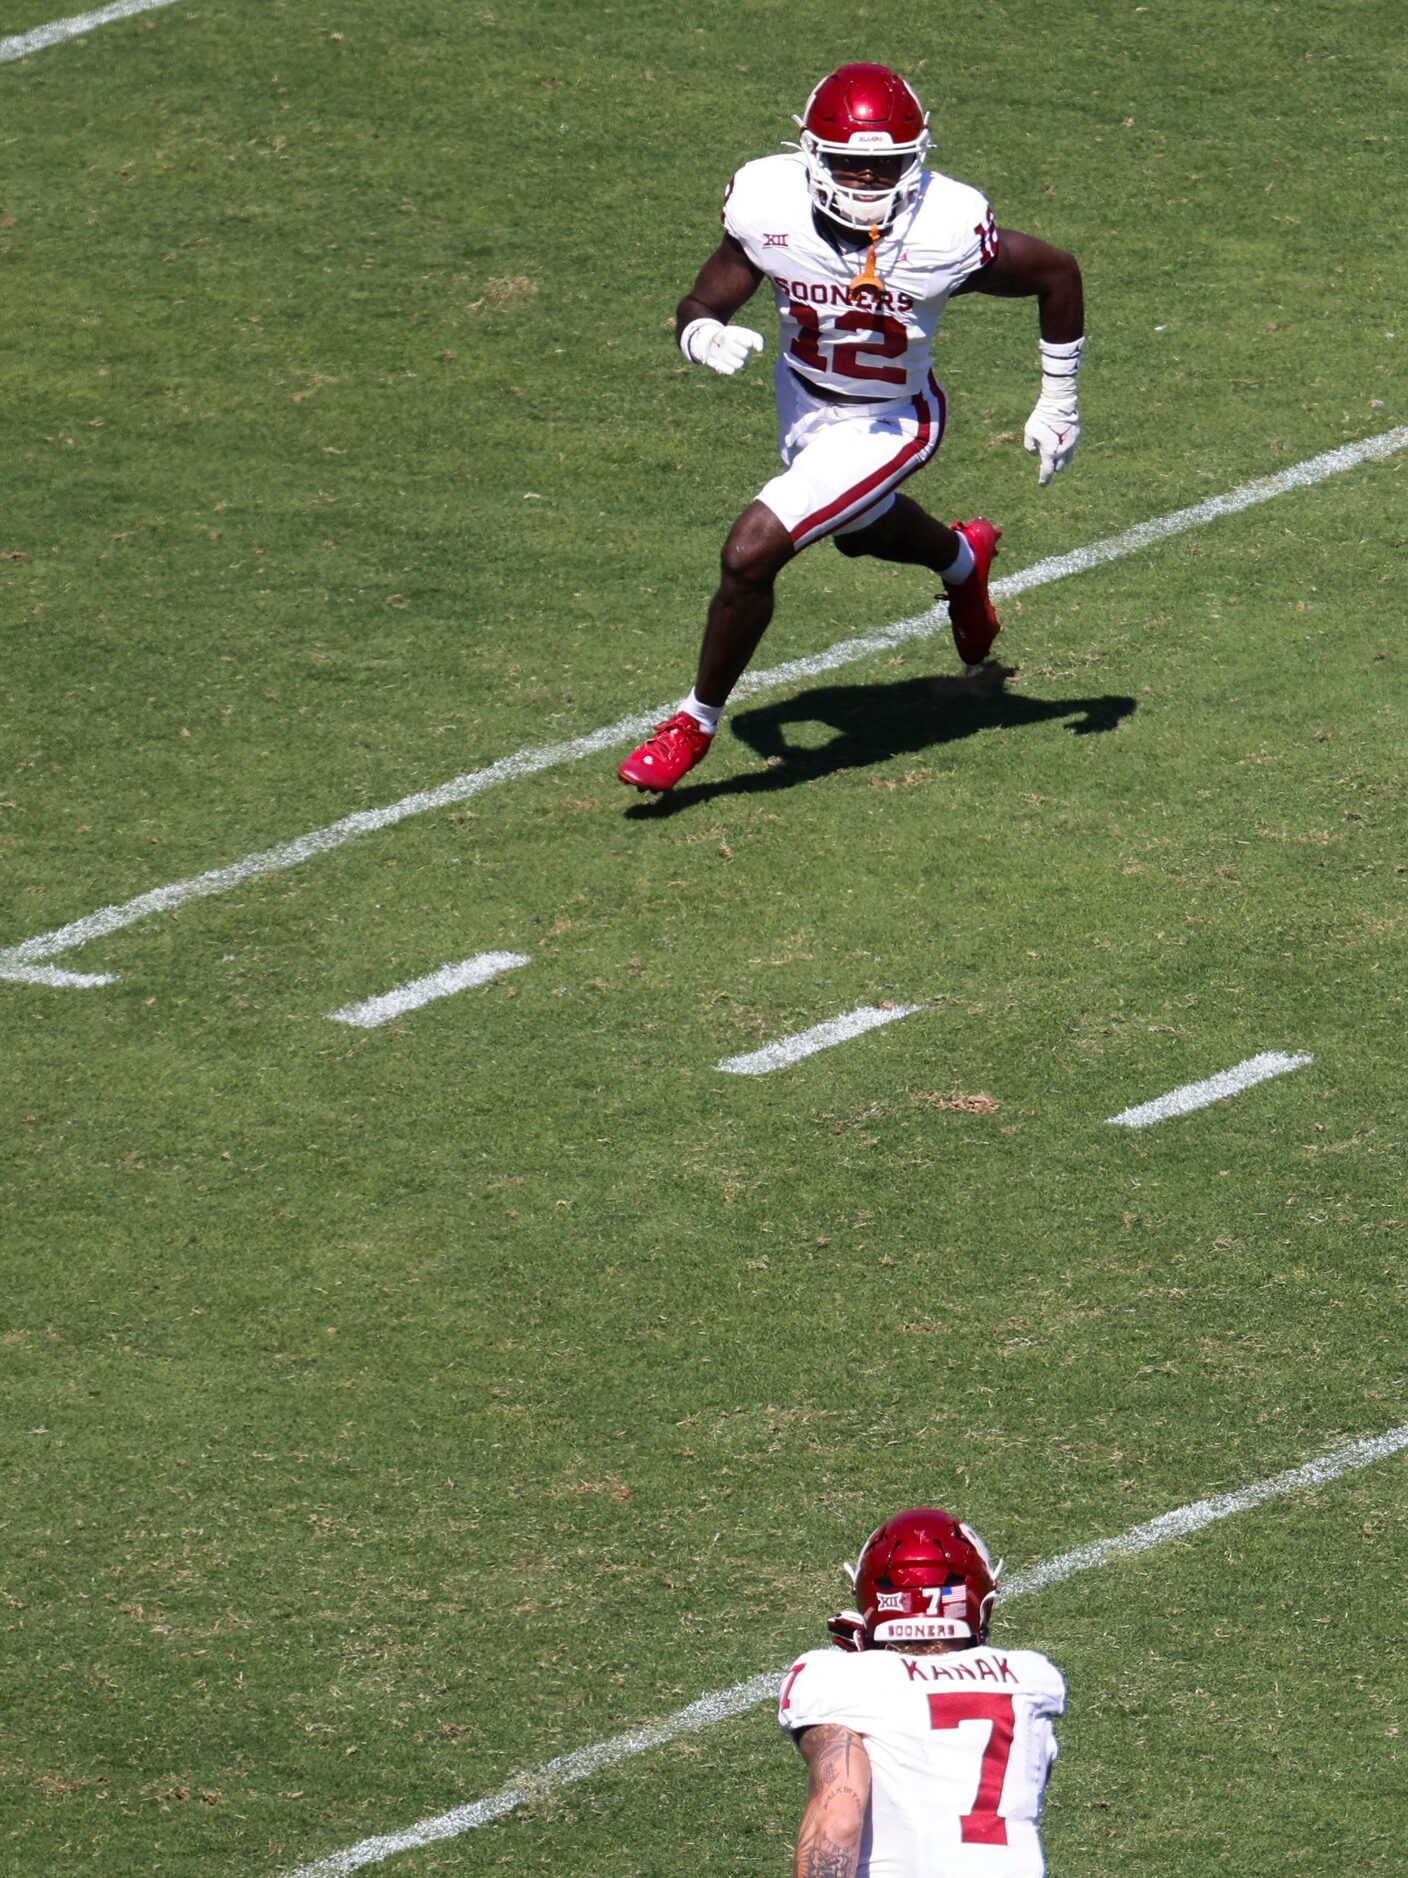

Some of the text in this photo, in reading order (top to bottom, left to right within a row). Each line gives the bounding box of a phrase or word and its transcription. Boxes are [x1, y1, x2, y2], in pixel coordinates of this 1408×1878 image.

[773, 276, 914, 313] SOONERS
[789, 300, 908, 385] 12
[921, 1587, 941, 1616] 7
[887, 1624, 956, 1639] SOONERS
[780, 1662, 807, 1711] 7
[900, 1655, 1020, 1684] KANAK
[927, 1691, 1016, 1846] 7
